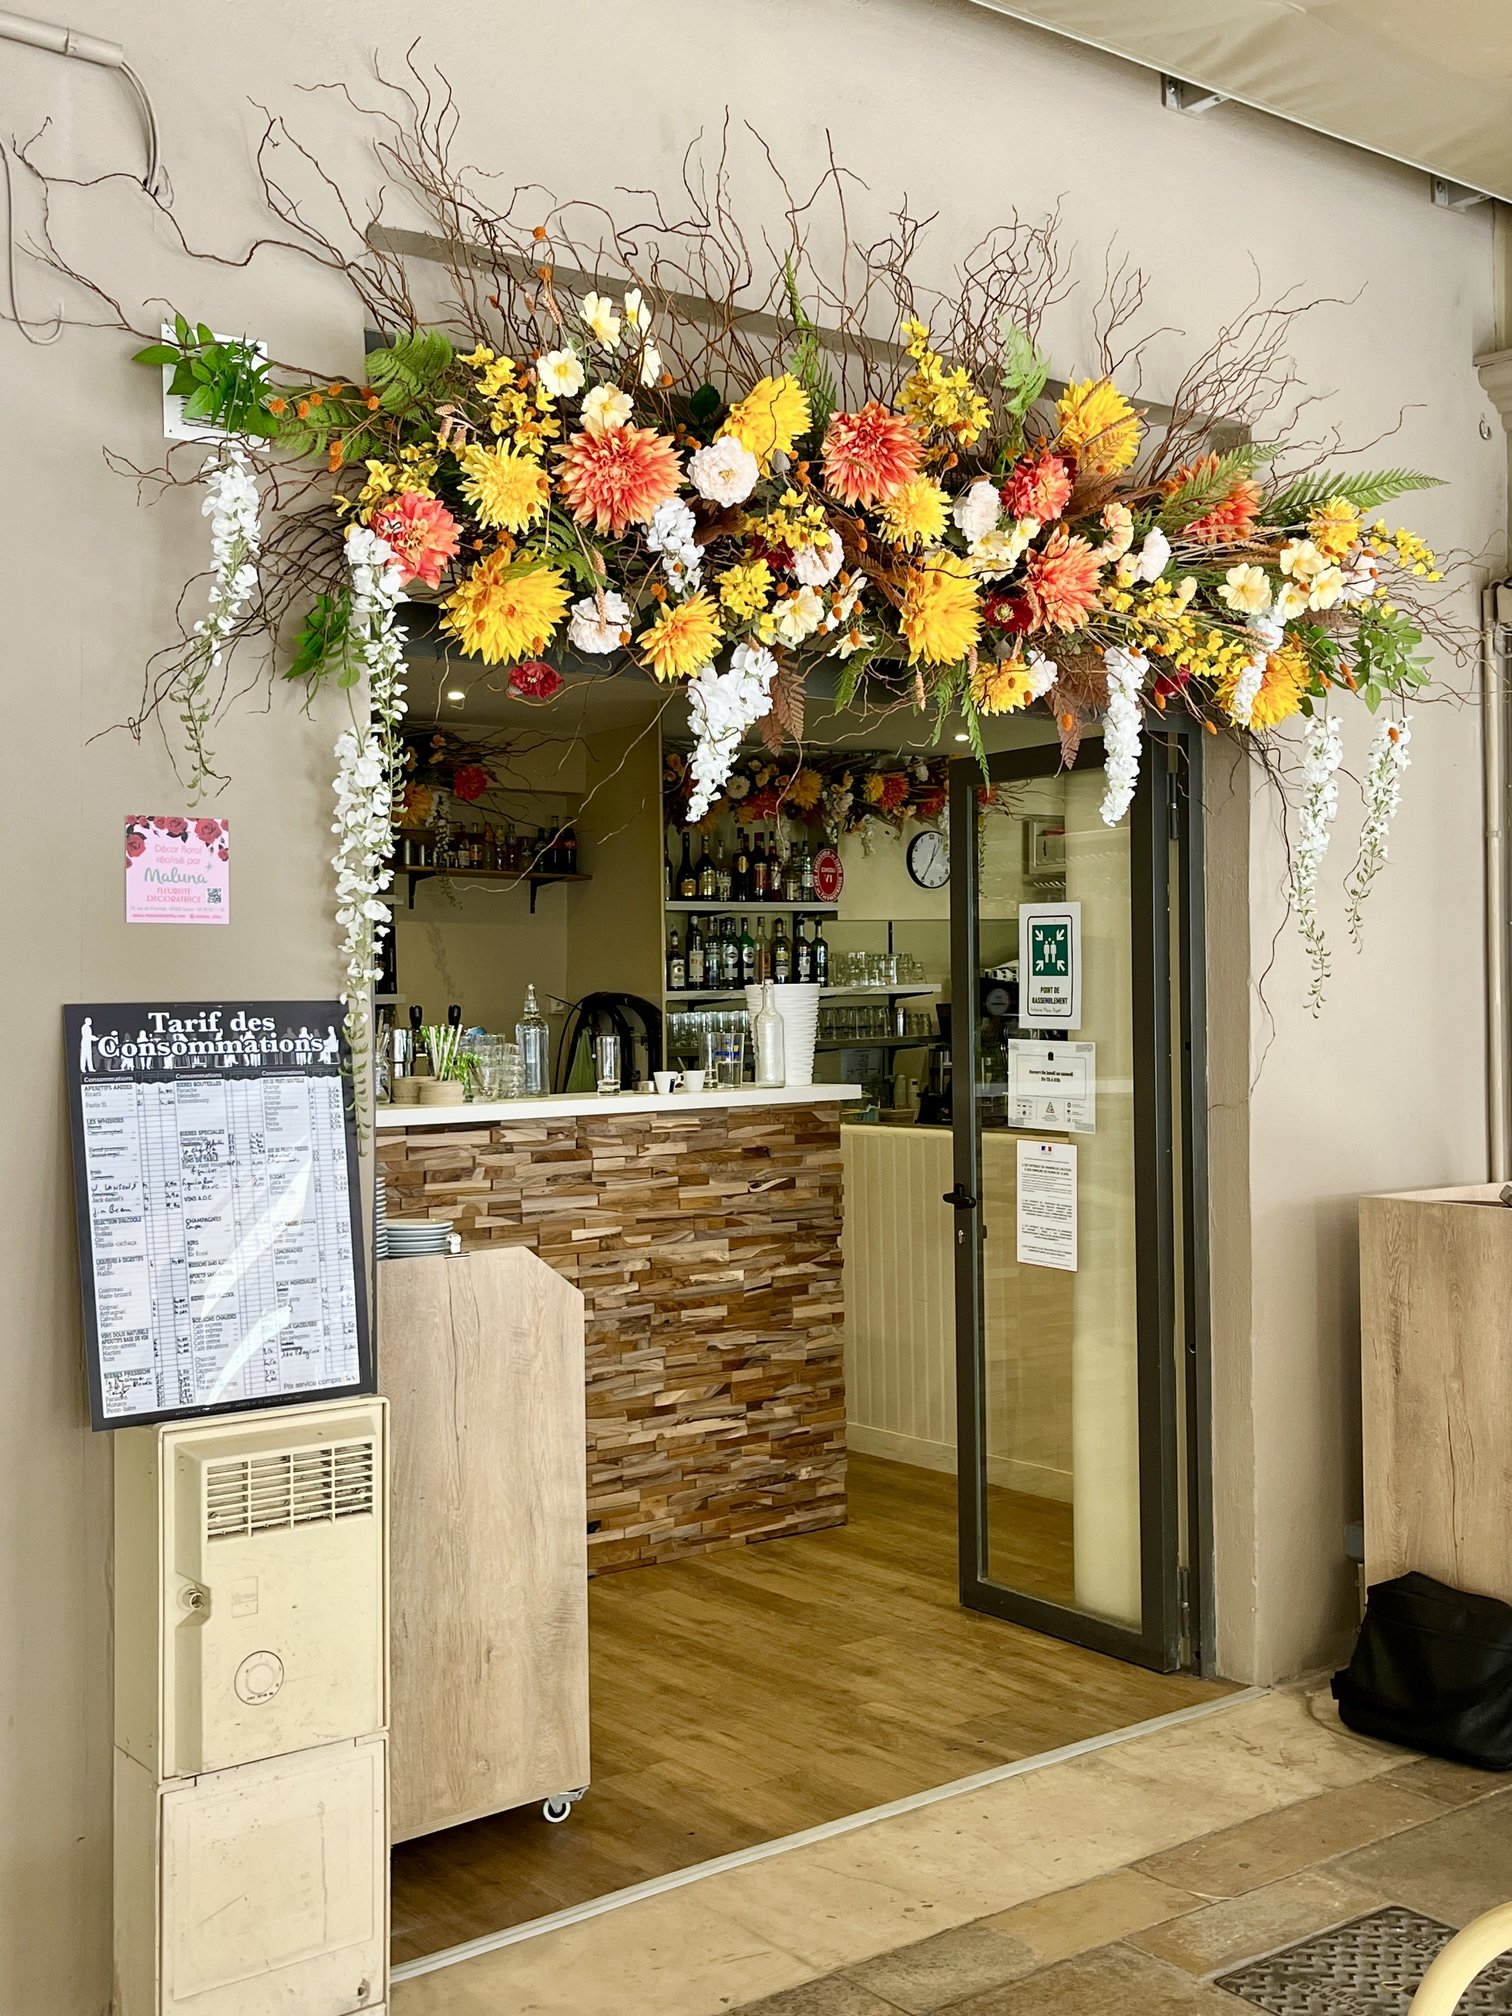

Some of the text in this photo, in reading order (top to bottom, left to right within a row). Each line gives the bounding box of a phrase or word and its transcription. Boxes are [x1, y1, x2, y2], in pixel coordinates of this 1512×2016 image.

[144, 867, 208, 884] Maluna
[148, 1011, 276, 1034] Tarif des
[99, 1032, 324, 1058] Consommations
